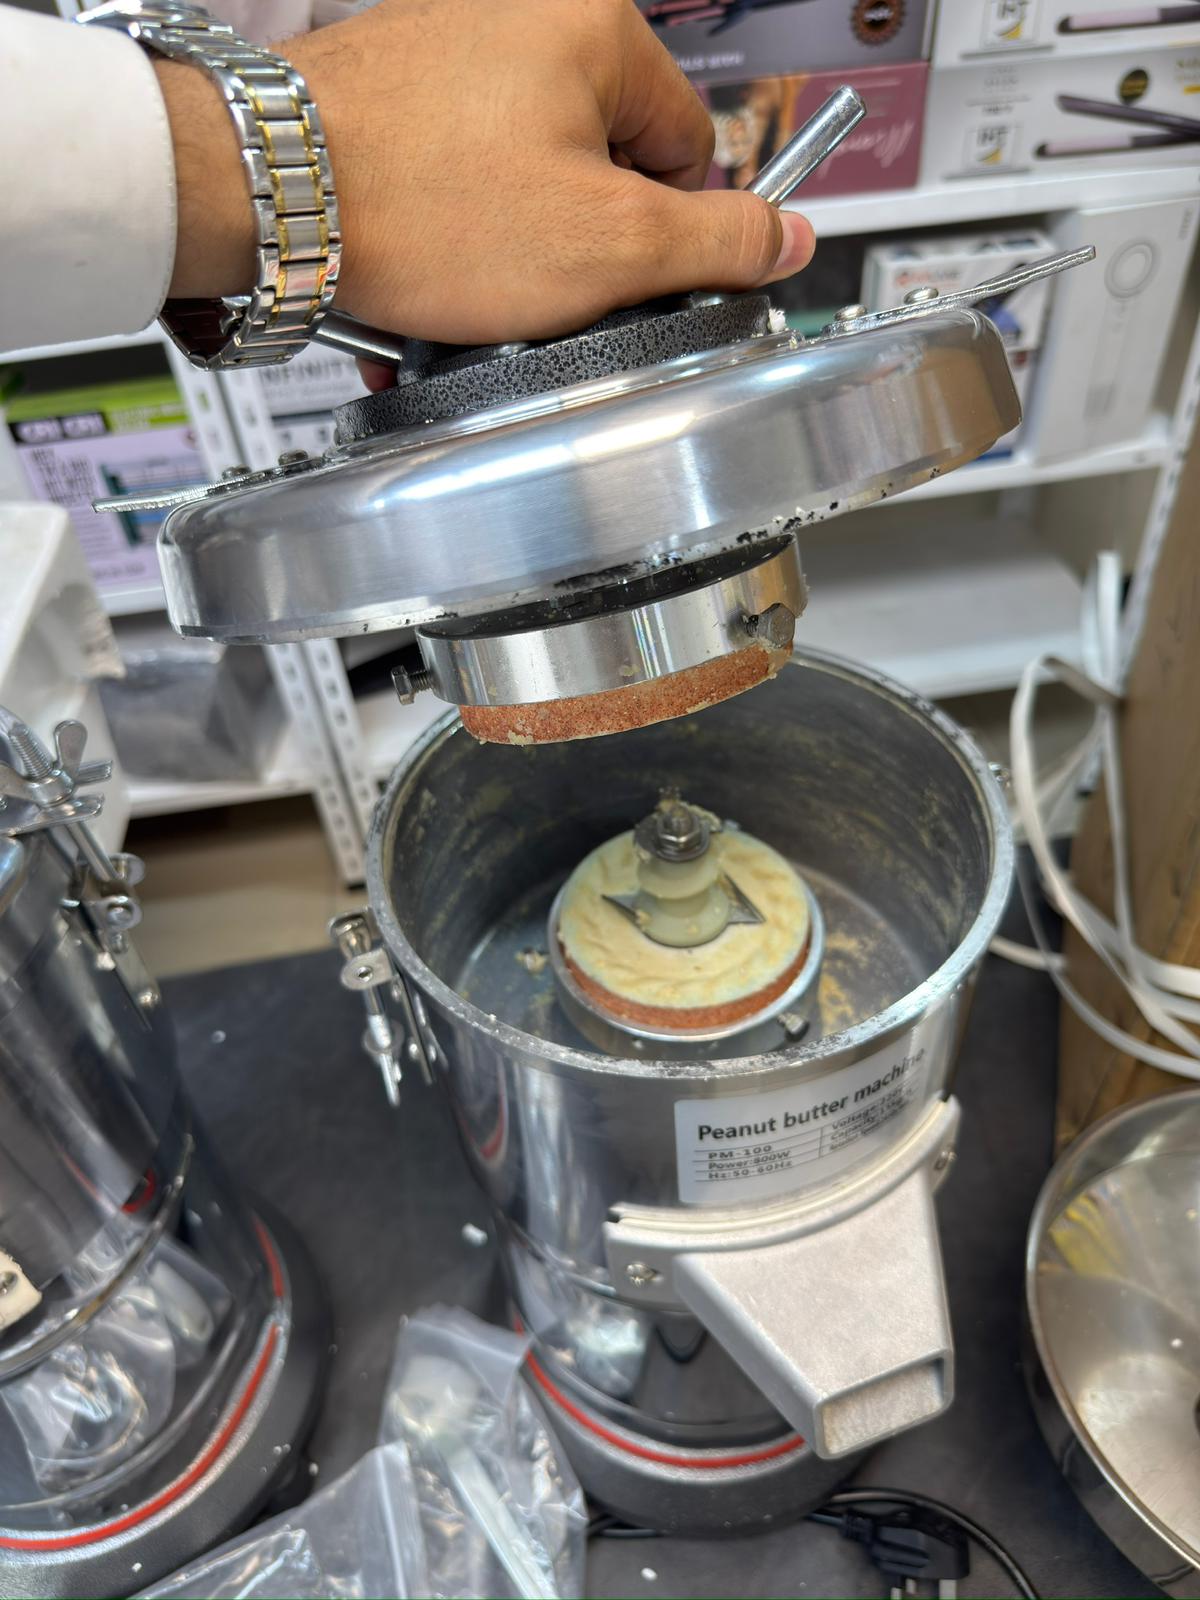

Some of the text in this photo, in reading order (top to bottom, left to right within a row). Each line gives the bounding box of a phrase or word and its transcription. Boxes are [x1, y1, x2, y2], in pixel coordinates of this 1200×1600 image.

[698, 1117, 776, 1141] Peanut
[784, 1095, 849, 1128] butter
[853, 1048, 925, 1103] machine
